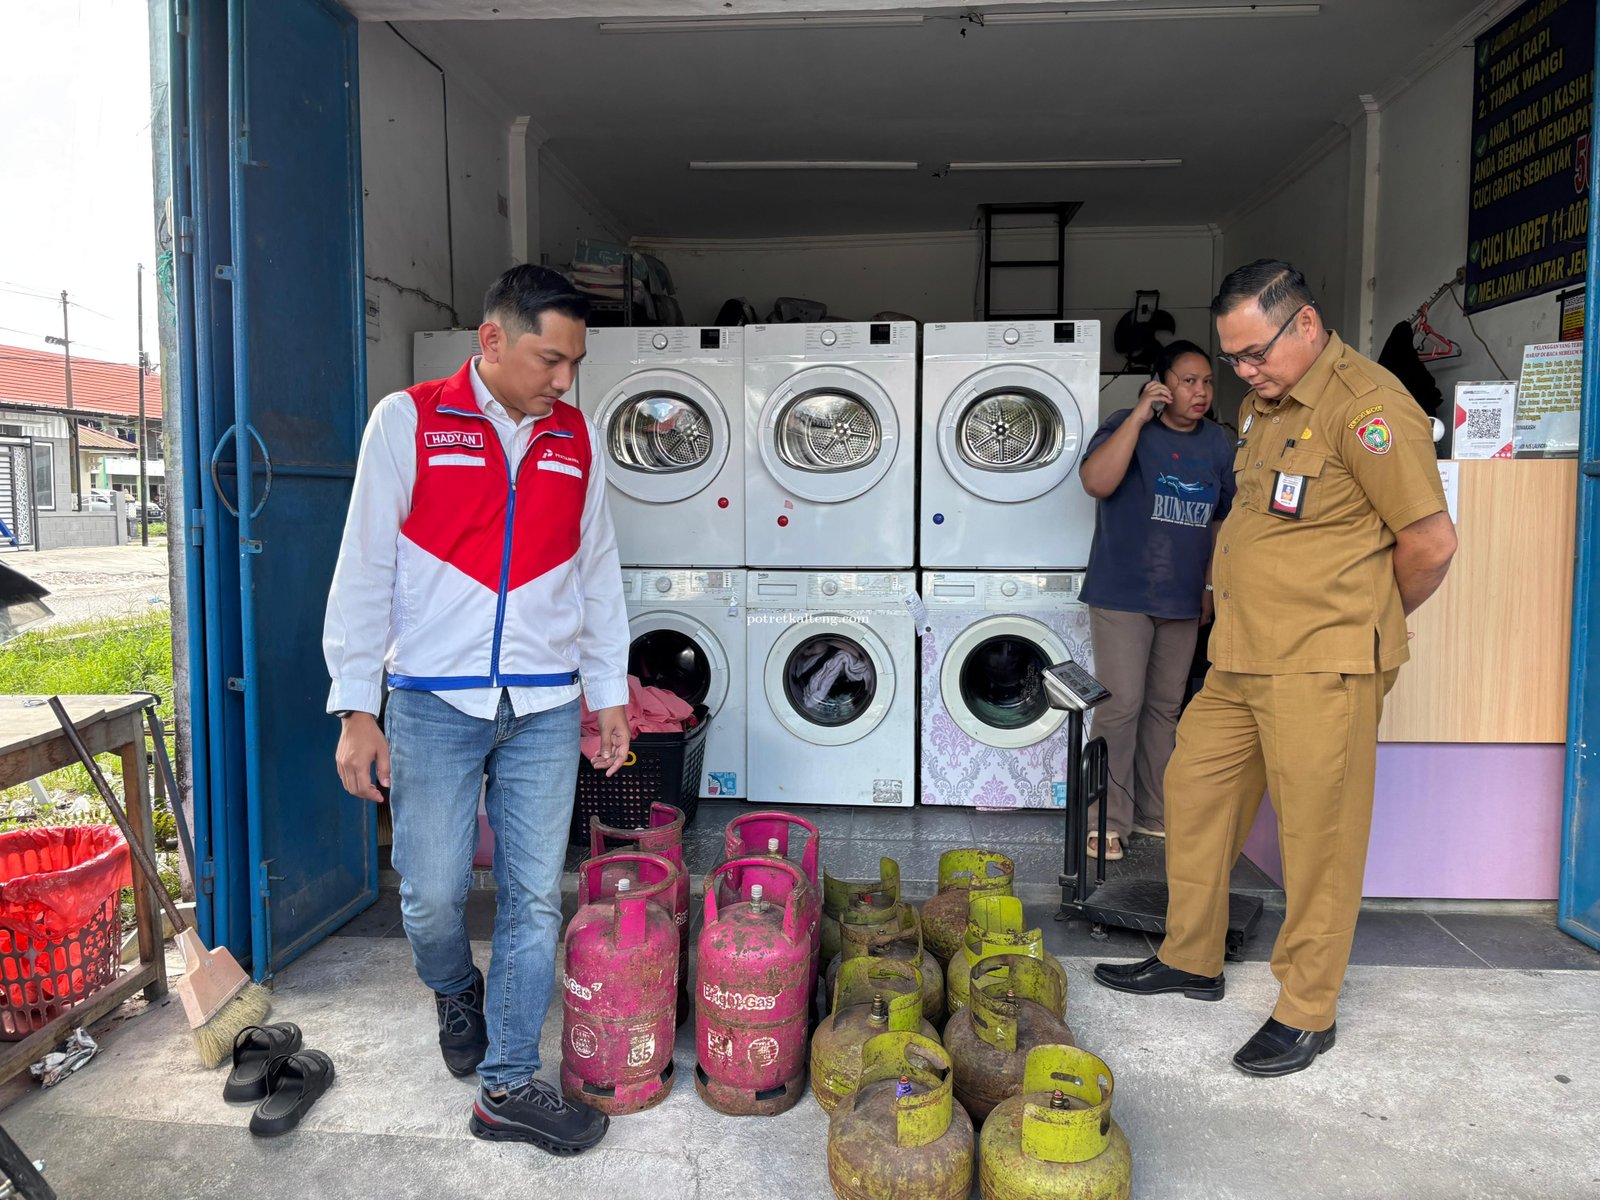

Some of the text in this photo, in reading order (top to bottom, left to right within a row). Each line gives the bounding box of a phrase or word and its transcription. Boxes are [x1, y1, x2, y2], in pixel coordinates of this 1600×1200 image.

[1478, 100, 1488, 119] 2.
[1489, 76, 1520, 111] TIDAK
[1522, 48, 1564, 90] WANGI
[1480, 73, 1488, 92] 1.
[1490, 48, 1521, 85] TIDAK
[1522, 27, 1551, 63] RAPI
[1488, 118, 1510, 149] ANDA
[1511, 101, 1540, 135] TIDAK
[1541, 94, 1552, 120] DI
[1554, 74, 1588, 112] KASIH
[1473, 187, 1491, 210] CUCI
[1492, 169, 1521, 202] GRATIS
[1522, 144, 1572, 188] SEBANYAK
[1474, 154, 1496, 185] ANDA
[1497, 132, 1536, 171] BERHAK
[1480, 232, 1503, 270] CUCI
[1505, 214, 1549, 260] KARPET
[1477, 267, 1526, 303] MELAYANI
[1527, 256, 1565, 289] ANTAR
[432, 434, 476, 445] HADYAN
[743, 993, 776, 1010] Gas
